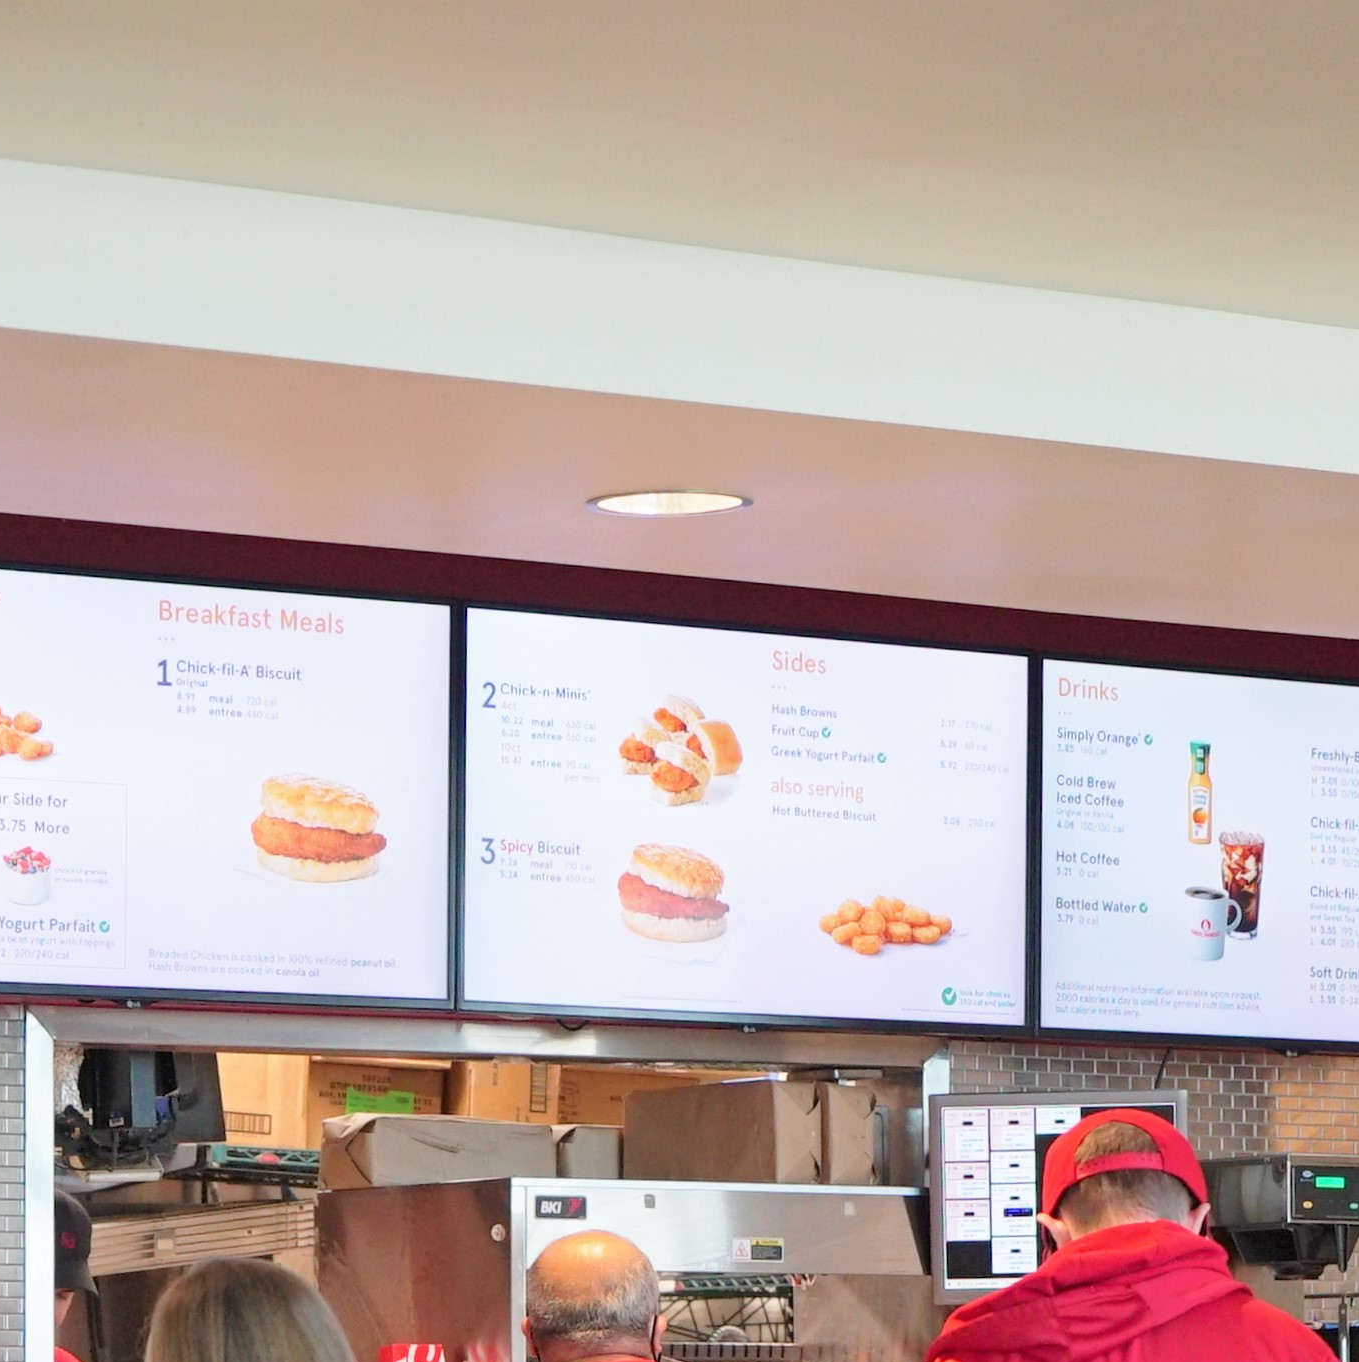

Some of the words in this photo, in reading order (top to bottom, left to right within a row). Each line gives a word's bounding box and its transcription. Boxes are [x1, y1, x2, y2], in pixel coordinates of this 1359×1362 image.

[159, 600, 271, 629] Breakfast
[280, 608, 345, 635] Meals
[772, 650, 827, 674] Sides
[156, 658, 173, 687] 1
[256, 665, 302, 681] Biscuit
[176, 677, 208, 690] Original
[1058, 677, 1119, 701] Drinks
[209, 694, 233, 704] meal
[481, 681, 497, 709] 2
[208, 706, 243, 718] entree
[772, 704, 797, 715] Hash
[800, 706, 837, 719] Browns
[531, 718, 554, 728] meal
[531, 731, 562, 742] entree
[771, 724, 795, 736] Fruit
[798, 726, 819, 740] Cup
[1056, 727, 1094, 745] Simply
[1097, 730, 1138, 747] Orange
[771, 746, 802, 758] Greek
[805, 748, 838, 762] Yogurt
[841, 751, 875, 764] Parfait
[531, 759, 562, 769] entree
[1056, 774, 1083, 788] Cold
[1087, 776, 1116, 789] Brew
[771, 777, 803, 795] also
[807, 780, 864, 804] serving
[13, 792, 43, 807] Side
[47, 793, 68, 808] for
[1056, 791, 1081, 804] Iced
[1085, 793, 1124, 808] Coffee
[772, 805, 791, 817] Hot
[794, 807, 839, 820] Buttered
[843, 810, 876, 822] Biscuit
[34, 820, 70, 835] More
[480, 837, 496, 865] 3
[500, 839, 534, 856] Spicy
[538, 840, 581, 856] Biscuit
[530, 860, 553, 870] meal
[1056, 850, 1077, 863] Hot
[1080, 851, 1120, 866] Coffee
[530, 872, 562, 882] entree
[1056, 896, 1099, 911] Bottled
[1101, 900, 1136, 914] Water
[49, 918, 96, 933] Parfait
[1310, 966, 1332, 979] Soft
[540, 1200, 562, 1214] BKI
